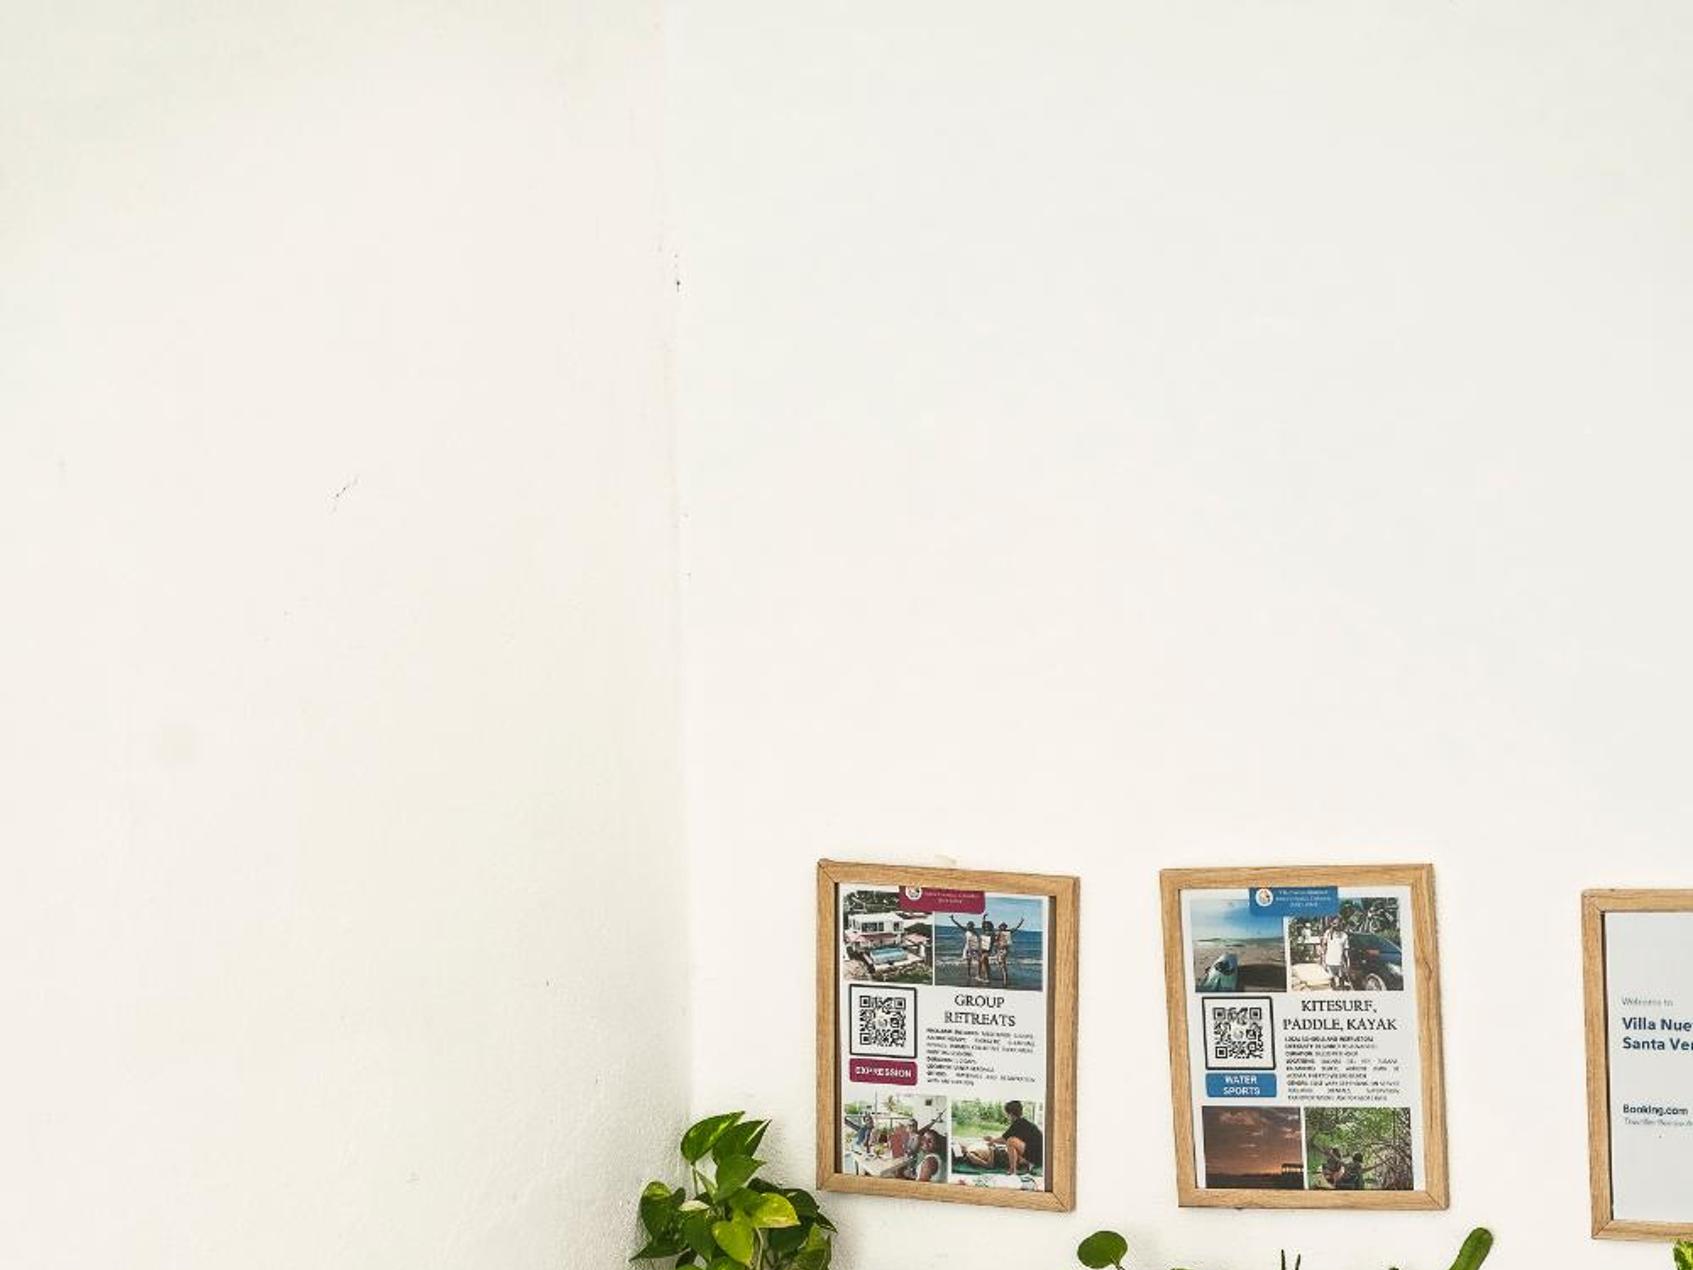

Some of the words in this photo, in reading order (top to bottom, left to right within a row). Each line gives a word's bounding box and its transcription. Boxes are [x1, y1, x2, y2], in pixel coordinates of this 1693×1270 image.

[954, 994, 1005, 1008] GROUP
[1301, 999, 1377, 1014] KITESURF,
[944, 1011, 1016, 1027] RETREATS
[1283, 1018, 1343, 1031] PADDLE,
[1347, 1017, 1398, 1031] KAYAK
[1622, 1017, 1656, 1031] Villa
[1660, 1018, 1693, 1032] Nue
[1622, 1036, 1666, 1051] Santa
[855, 1066, 912, 1078] EXPRESSION
[1224, 1075, 1257, 1085] WATER
[1223, 1086, 1261, 1096] SPORTS
[1622, 1103, 1689, 1116] Booking.com
